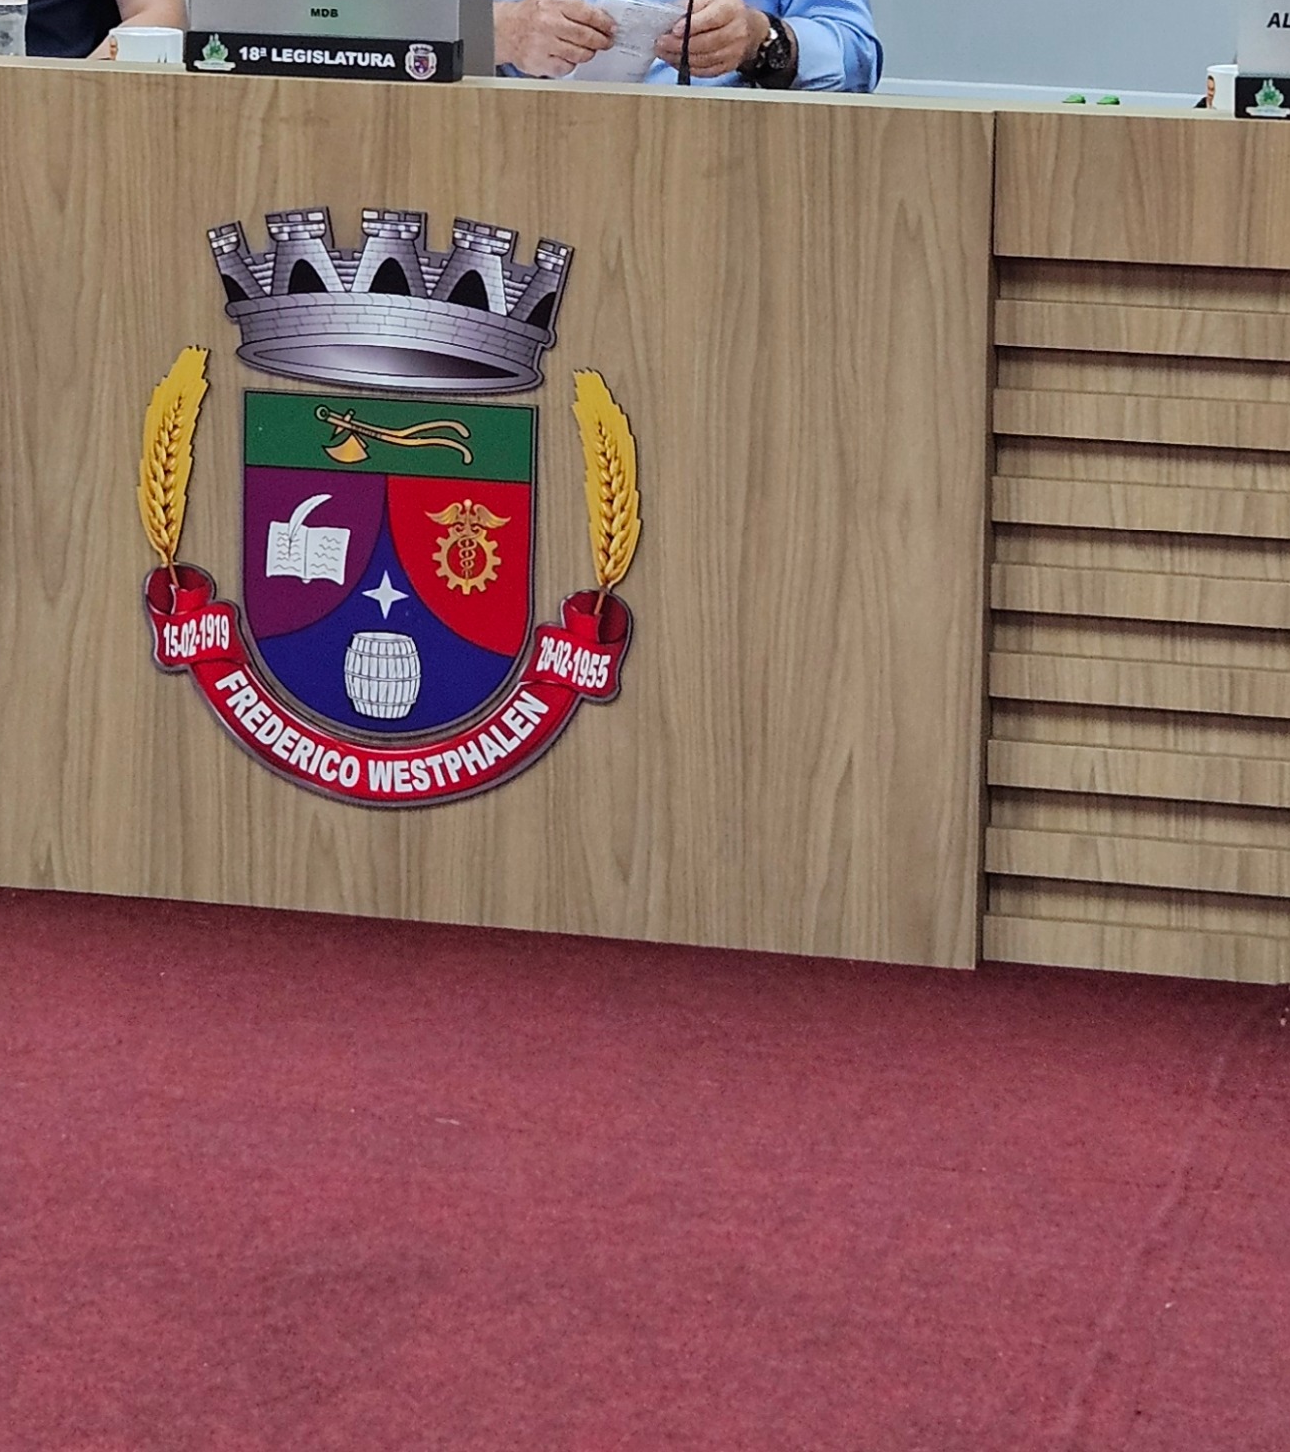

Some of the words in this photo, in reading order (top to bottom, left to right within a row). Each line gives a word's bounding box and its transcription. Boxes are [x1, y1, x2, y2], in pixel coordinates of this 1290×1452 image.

[311, 8, 338, 17] MDB
[239, 46, 267, 60] 18ª
[272, 49, 395, 68] LEGISLATURA
[164, 614, 229, 658] 15-02-1919
[537, 636, 608, 687] 28-02-1955
[215, 670, 360, 787] FREDERICO
[368, 692, 549, 793] WESTPHALEN
